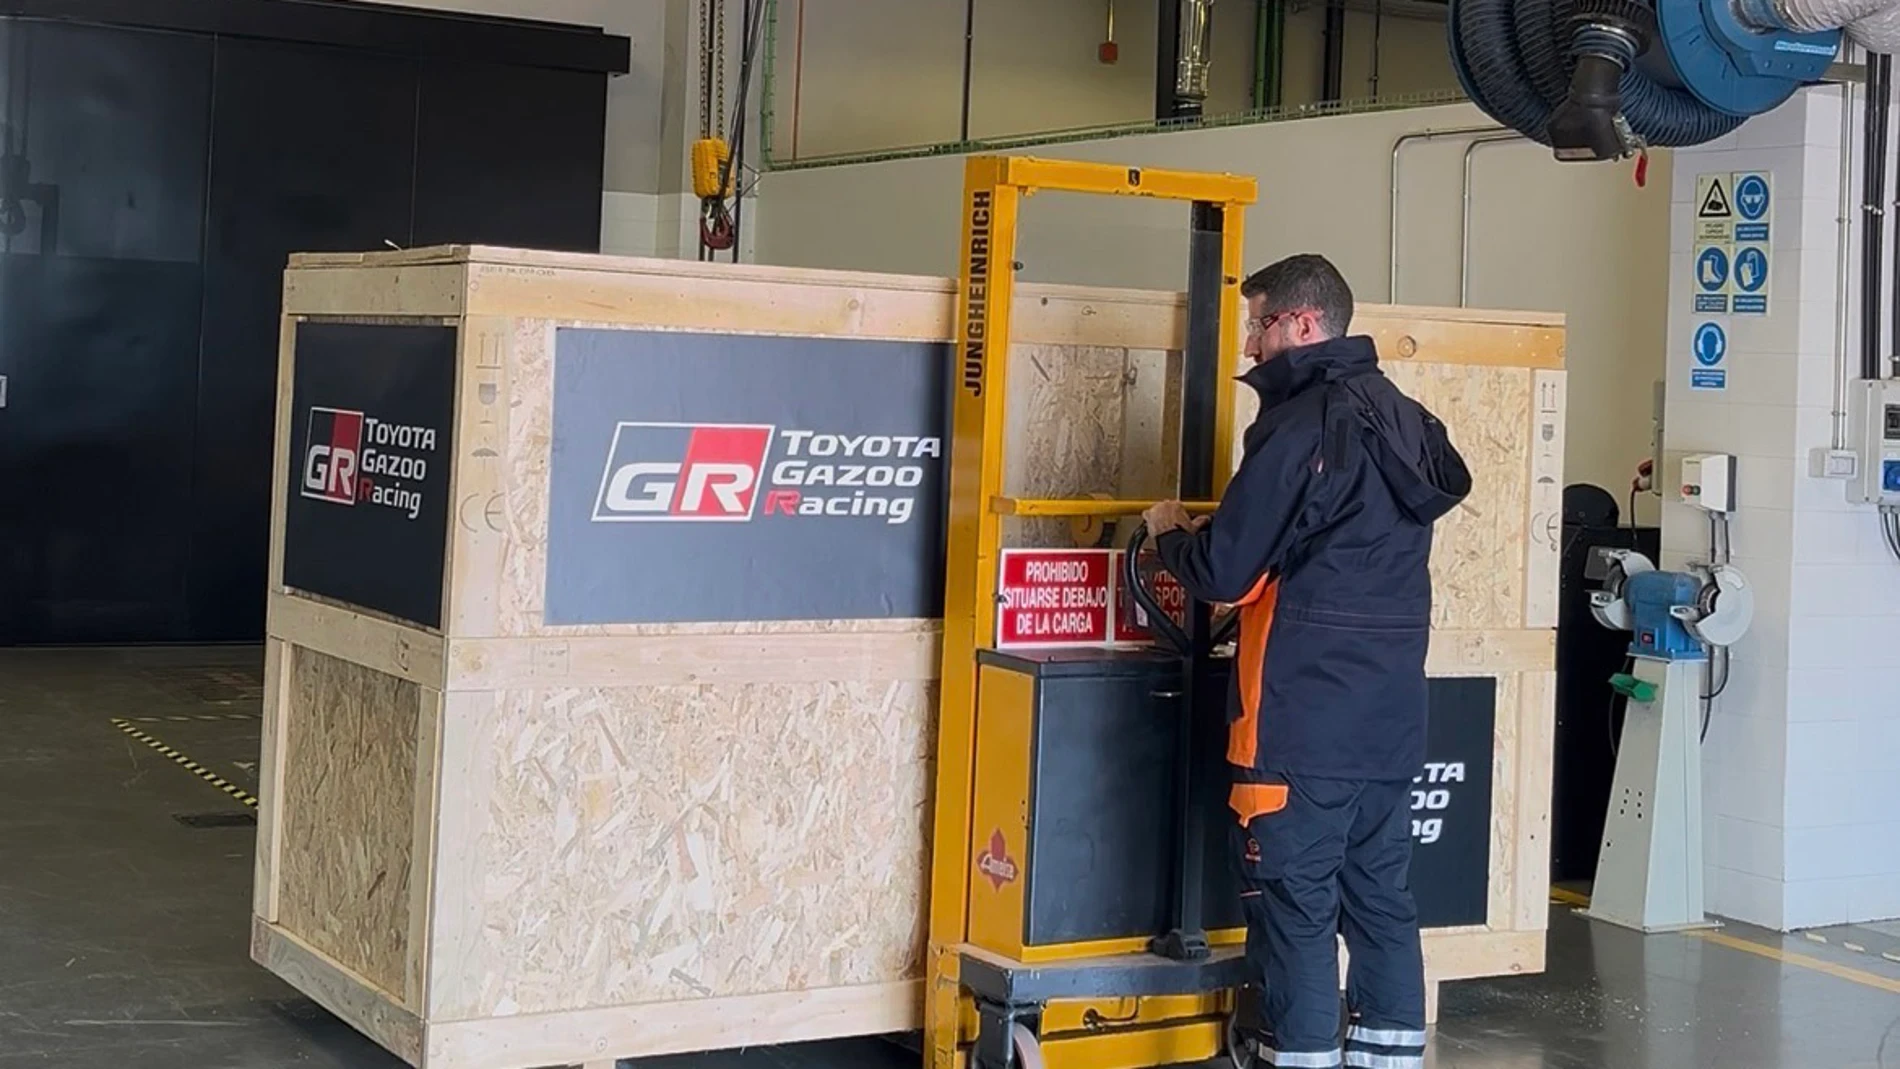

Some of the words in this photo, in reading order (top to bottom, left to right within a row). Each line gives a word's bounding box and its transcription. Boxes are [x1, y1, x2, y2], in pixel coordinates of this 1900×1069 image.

[965, 191, 990, 396] JUNGHEINRICH
[365, 418, 436, 451] TOYOTA
[781, 430, 941, 458] TOYOTA
[306, 444, 355, 497] GR
[361, 448, 427, 481] GAZOO
[771, 461, 923, 486] GAZOO
[359, 477, 421, 519] Racing
[606, 462, 754, 513] GR
[764, 490, 915, 524] Racing
[1025, 560, 1089, 583] PROHIBIDO
[1003, 586, 1061, 609] SITUARSE
[1062, 586, 1108, 608] DEBAJO
[1016, 613, 1033, 635] DE
[1035, 612, 1050, 634] LA
[1052, 612, 1093, 634] CARGA
